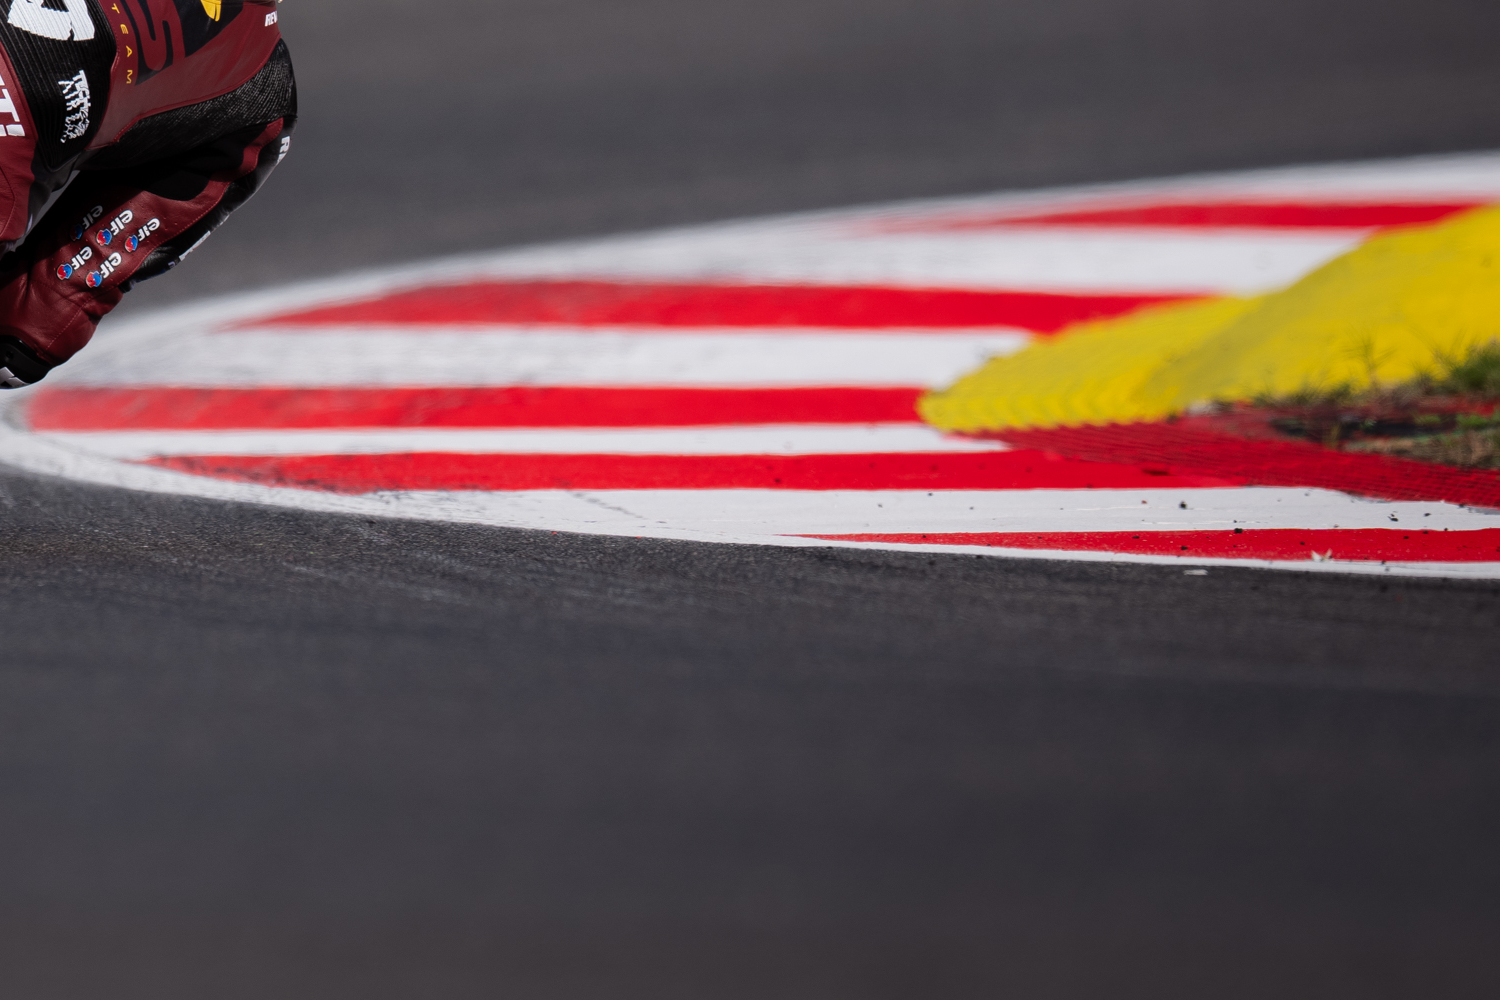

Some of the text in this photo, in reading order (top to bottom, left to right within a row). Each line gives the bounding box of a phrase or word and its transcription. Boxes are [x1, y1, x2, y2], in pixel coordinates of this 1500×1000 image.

[111, 2, 134, 85] TEAM
[82, 205, 103, 229] elf
[110, 209, 133, 236] elf
[138, 218, 160, 241] elf
[71, 246, 93, 270] elf
[100, 252, 122, 278] elf
